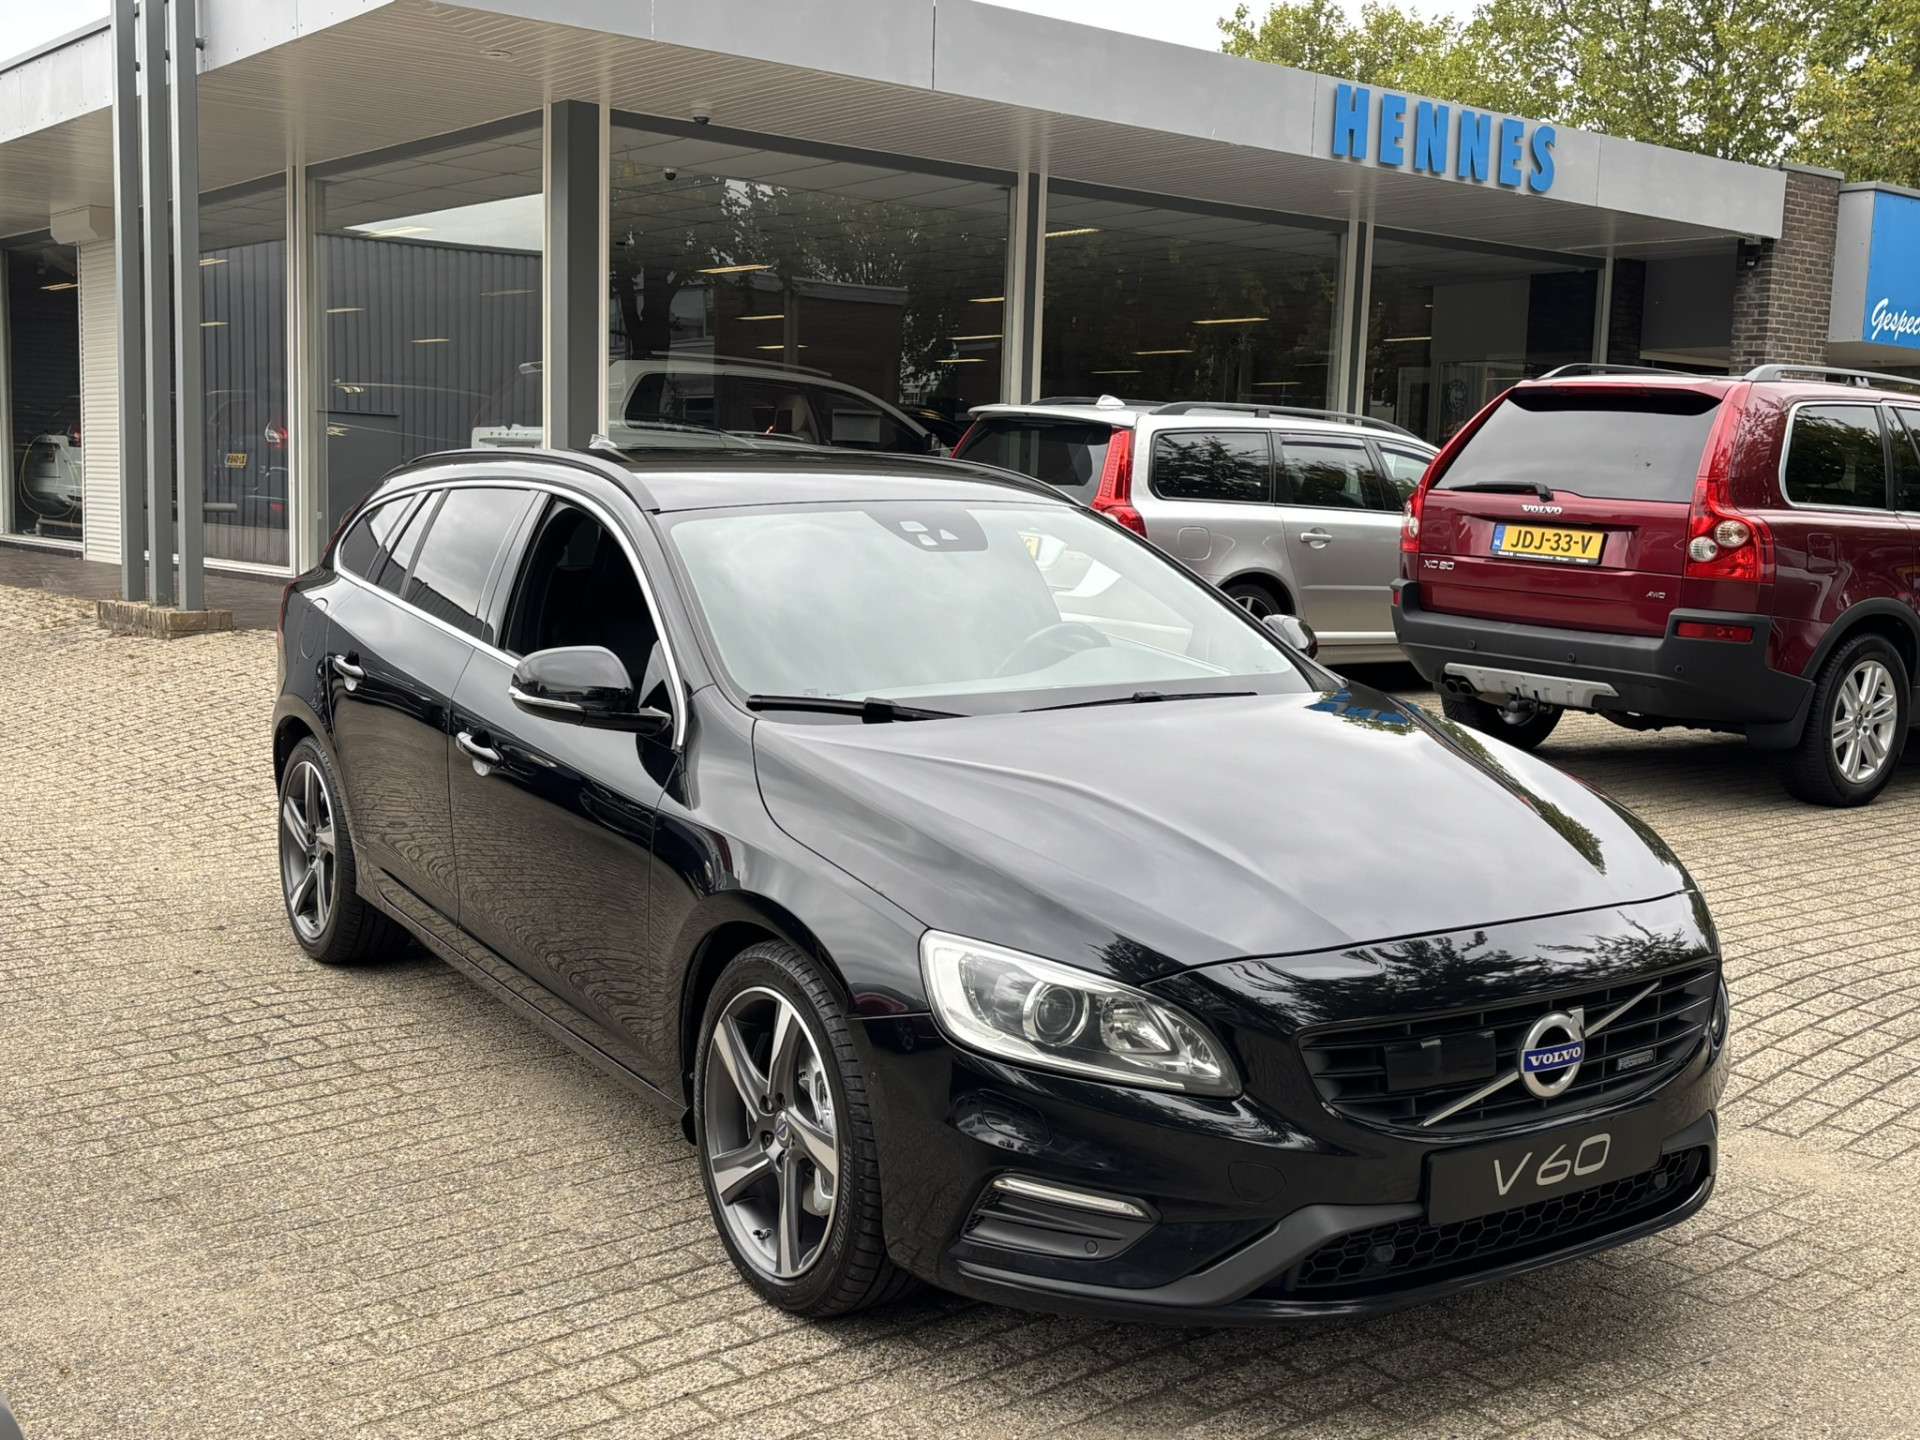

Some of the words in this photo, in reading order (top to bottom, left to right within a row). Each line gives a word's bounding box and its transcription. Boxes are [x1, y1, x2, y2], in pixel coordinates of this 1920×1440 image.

[1333, 84, 1556, 193] HENNES
[1521, 504, 1563, 515] VOLVO
[1510, 529, 1593, 554] JDJ-33-V
[1528, 1047, 1582, 1066] VOLVO
